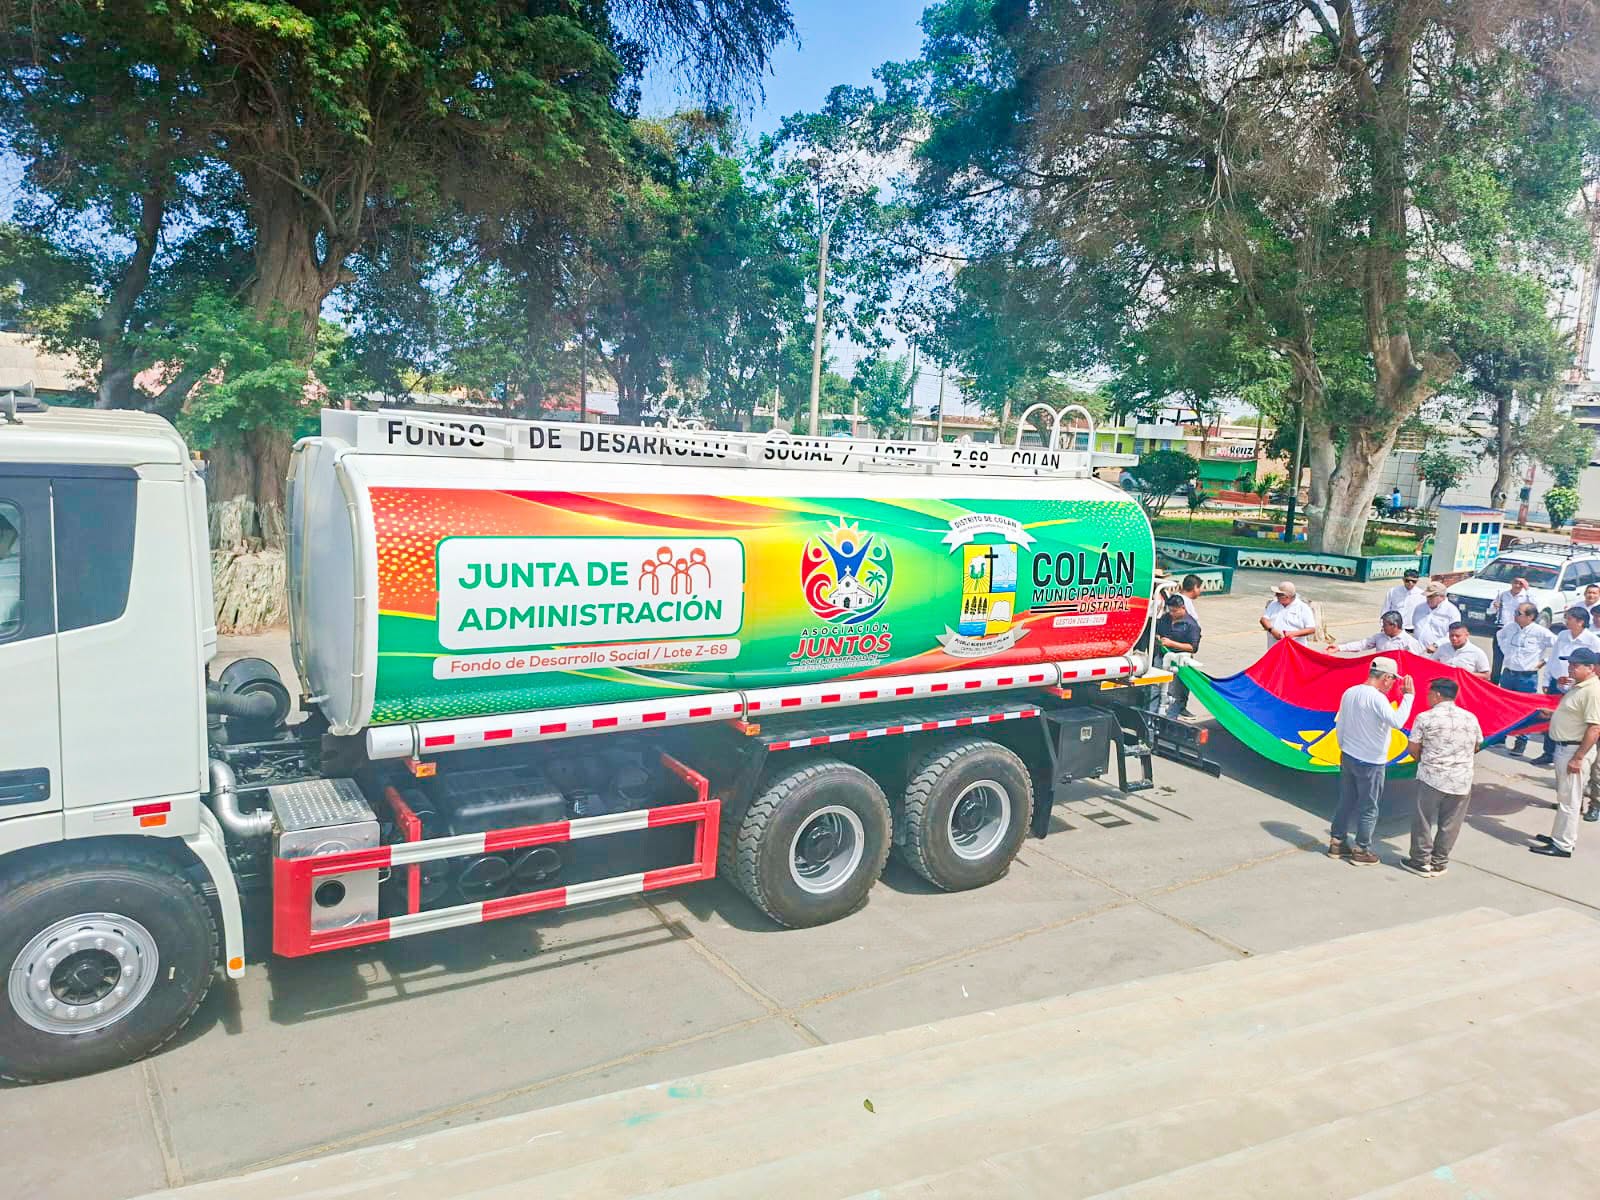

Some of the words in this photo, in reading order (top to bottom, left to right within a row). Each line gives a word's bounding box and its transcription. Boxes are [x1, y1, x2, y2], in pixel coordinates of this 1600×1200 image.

[529, 426, 562, 449] DE
[458, 561, 580, 589] JUNTA
[587, 561, 629, 586] DE
[1032, 542, 1135, 587] COLÁN
[1032, 586, 1133, 602] MUNICIPALIDAD
[1080, 600, 1129, 613] DISTRITAL
[457, 595, 722, 632] ADMINISTRACIÓN
[801, 622, 889, 636] ASOCIACIÓN
[451, 658, 501, 673] Fondo
[505, 657, 525, 669] de
[529, 651, 606, 668] Desarrollo
[609, 648, 650, 662] Social
[653, 646, 661, 660] /
[664, 647, 693, 659] Lote
[695, 643, 728, 657] Z-69
[790, 633, 892, 659] JUNTOS
